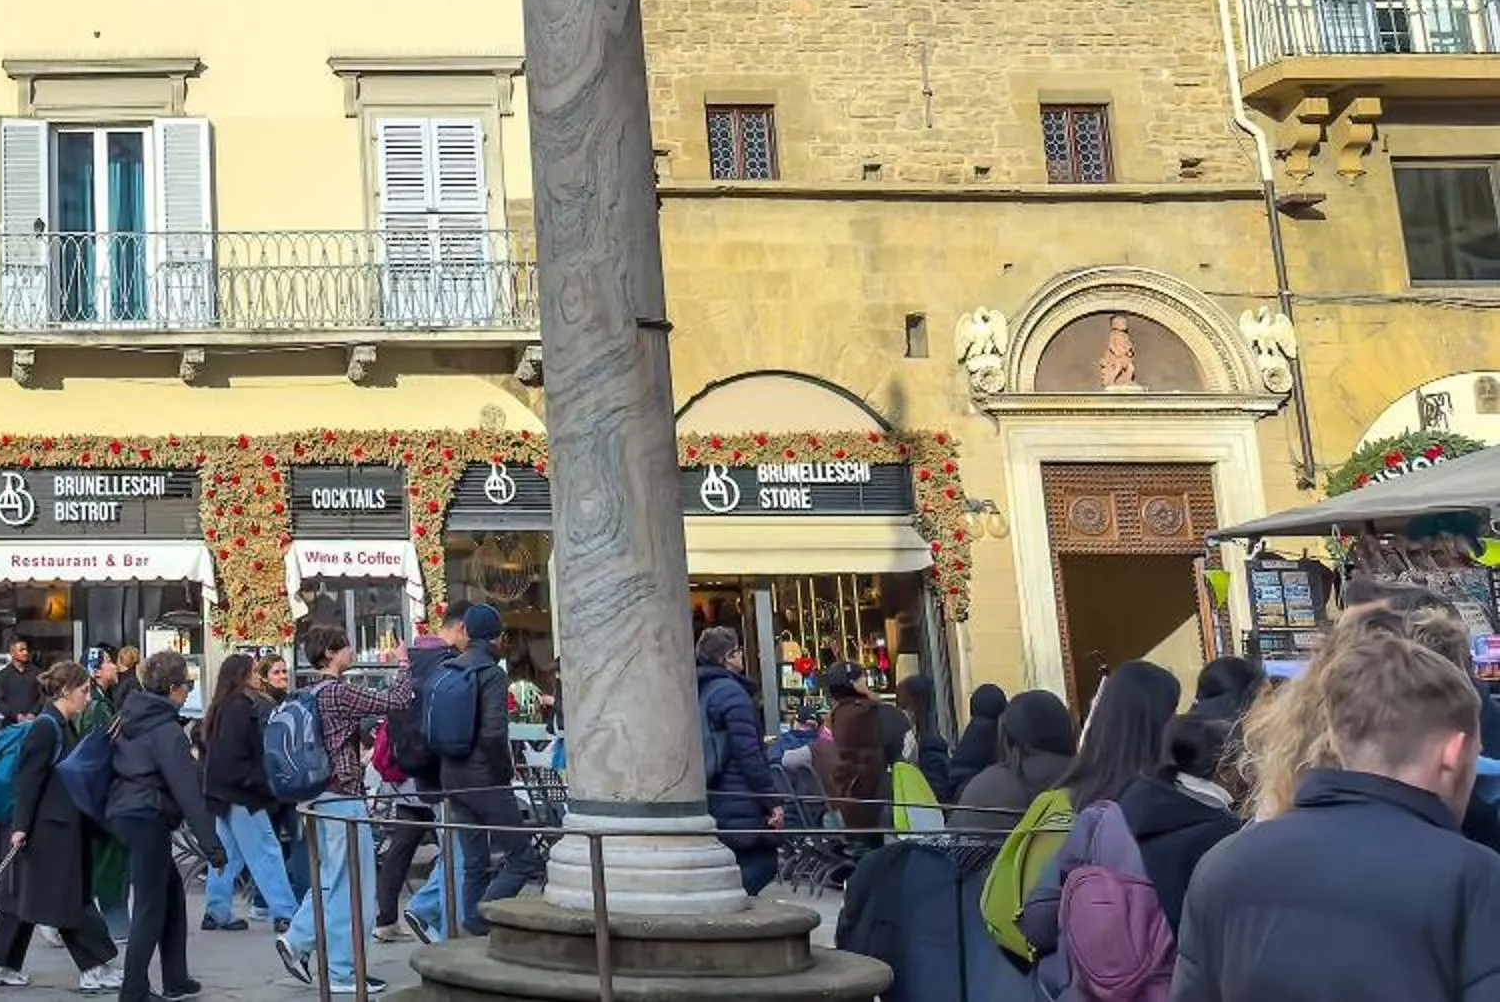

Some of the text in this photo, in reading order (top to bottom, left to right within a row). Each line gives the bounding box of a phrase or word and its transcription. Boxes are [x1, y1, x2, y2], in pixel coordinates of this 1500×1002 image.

[756, 461, 872, 483] BRUNELLESCHI
[53, 475, 166, 496] BRUNELLESCHI
[311, 487, 387, 510] COCKTAILS
[759, 486, 813, 509] STORE
[54, 500, 118, 522] BISTROT
[10, 554, 150, 568] Restaurant & Bar
[304, 551, 401, 566] Wine & Coffee
